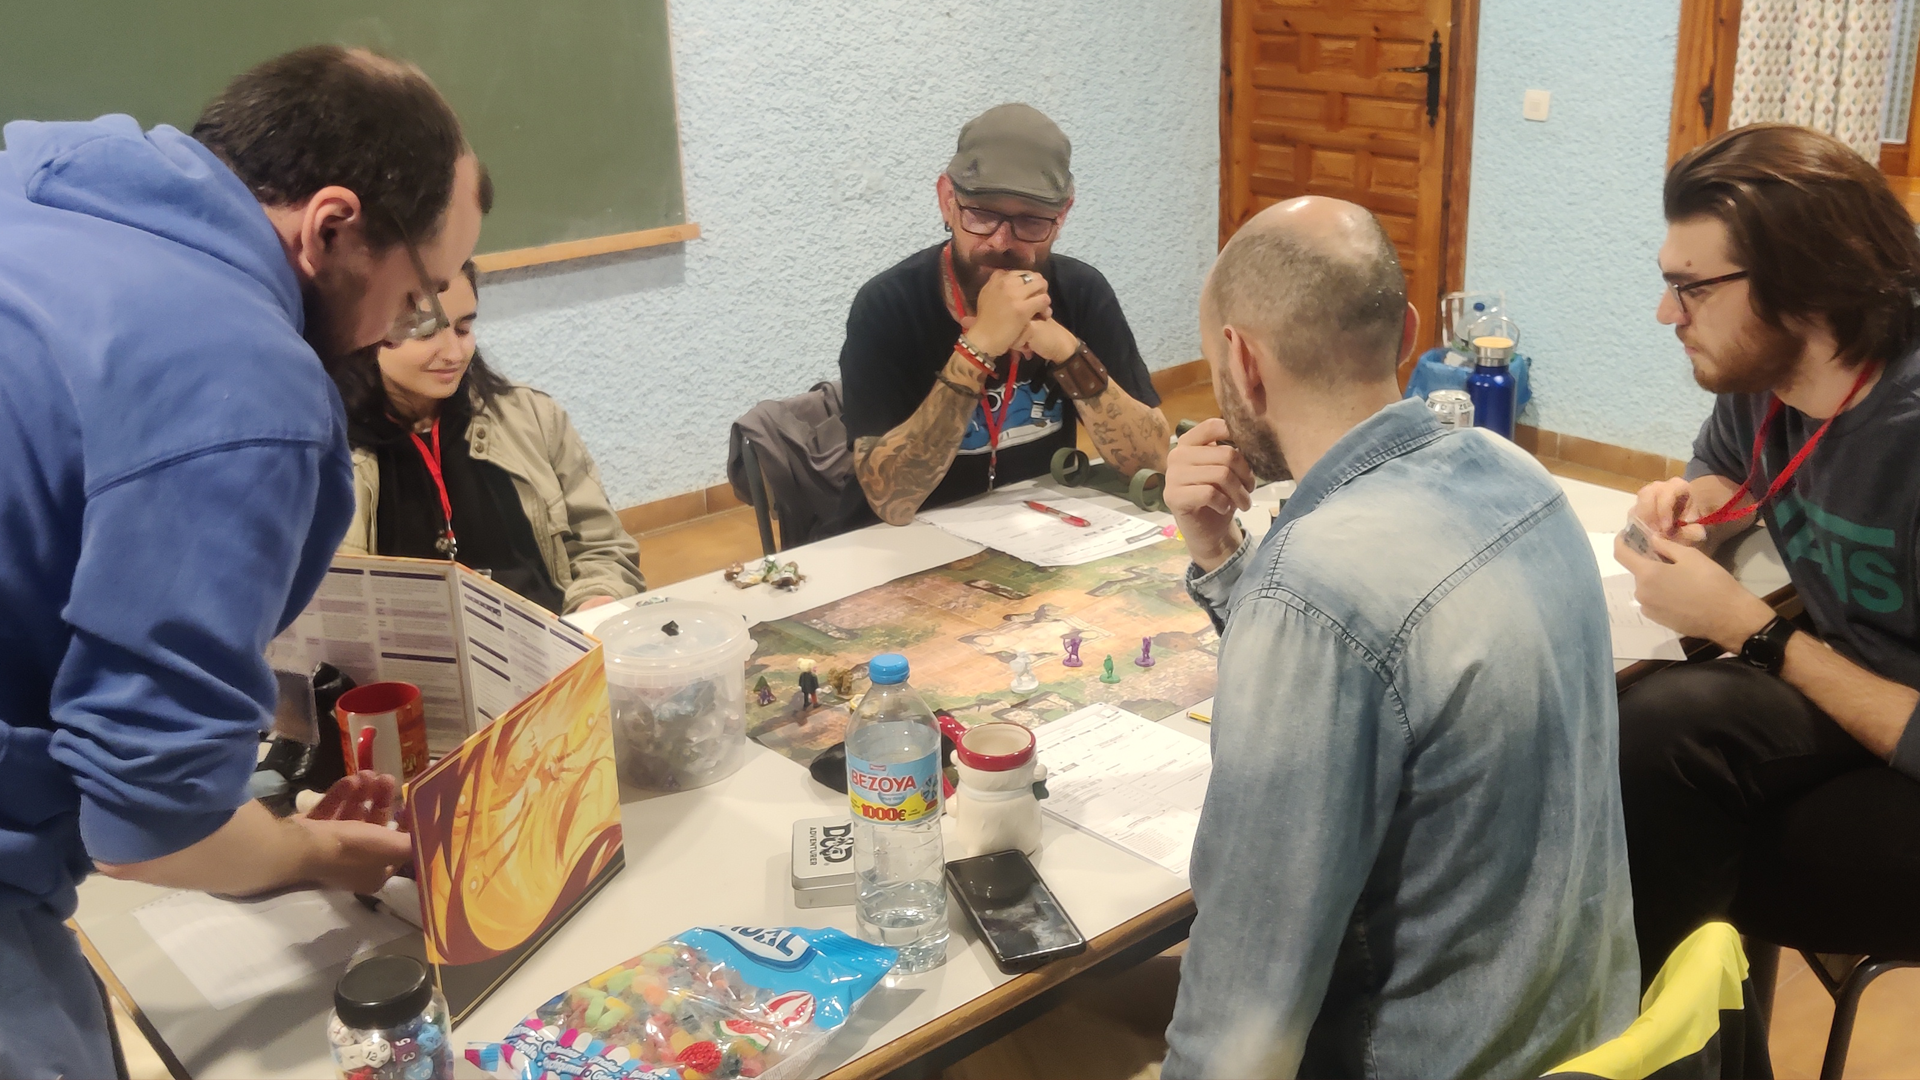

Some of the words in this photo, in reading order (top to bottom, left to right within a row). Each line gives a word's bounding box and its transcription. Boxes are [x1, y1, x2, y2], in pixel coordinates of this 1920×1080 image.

[851, 769, 917, 793] BEZOYA
[861, 803, 907, 821] 1000€
[809, 826, 818, 866] ADVENTURER
[729, 926, 794, 957] DAL
[365, 1051, 378, 1062] 12
